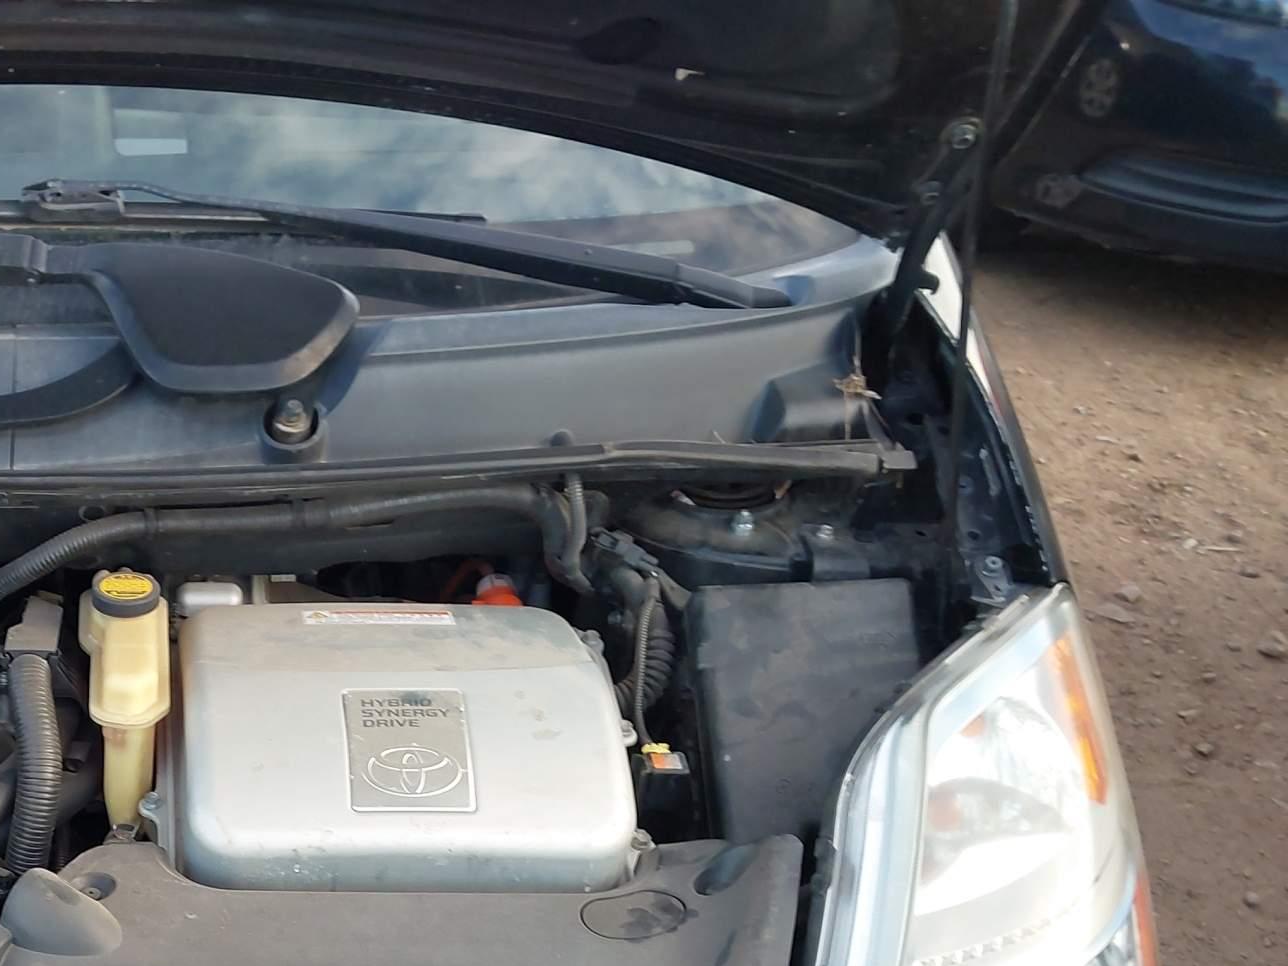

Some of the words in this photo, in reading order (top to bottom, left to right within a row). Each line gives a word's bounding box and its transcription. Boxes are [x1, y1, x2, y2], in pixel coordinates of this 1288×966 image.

[360, 698, 432, 707] HYBRID
[361, 708, 449, 718] SYNERGY
[362, 719, 420, 728] DRIVE
